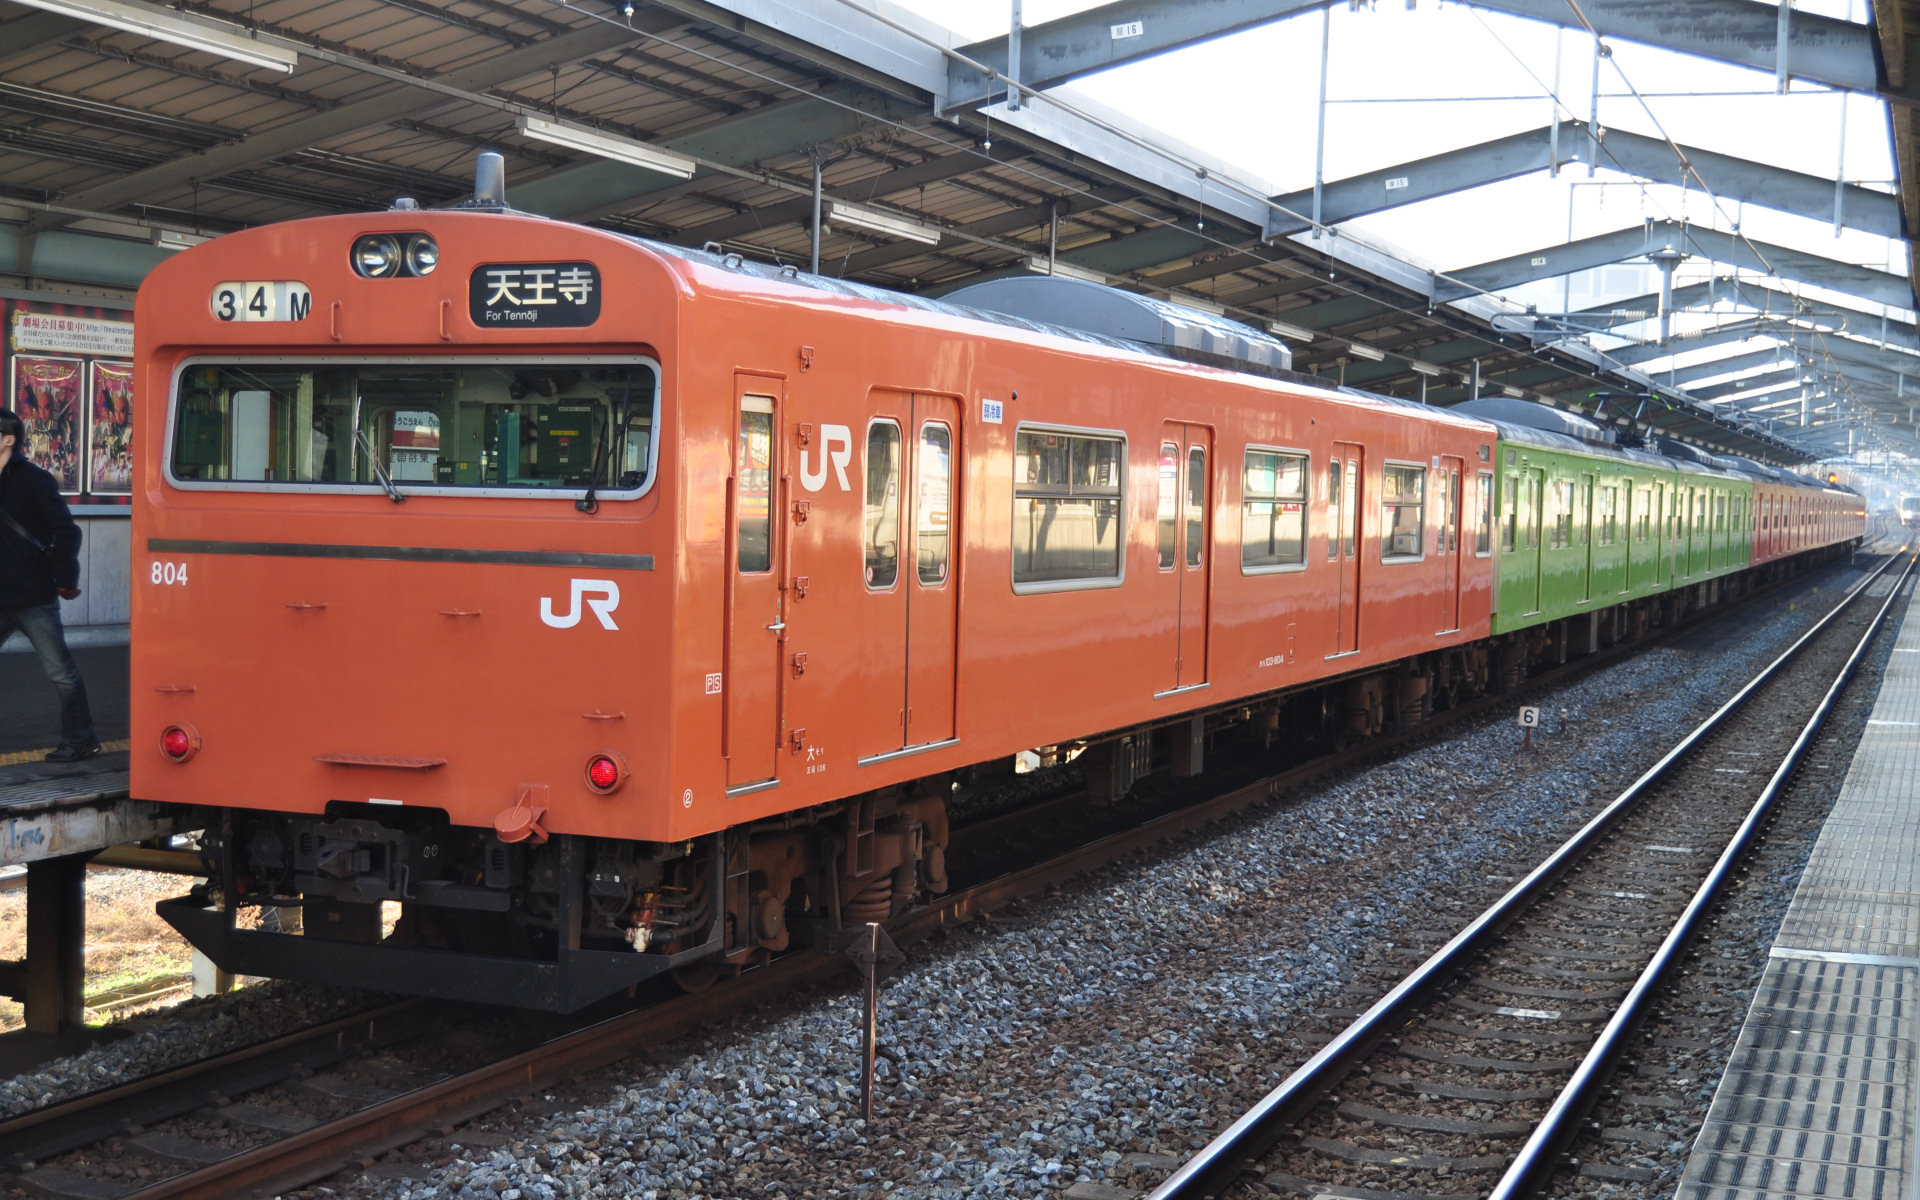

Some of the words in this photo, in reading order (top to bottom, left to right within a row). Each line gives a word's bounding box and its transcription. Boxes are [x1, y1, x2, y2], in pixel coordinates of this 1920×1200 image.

[1128, 24, 1137, 35] 16
[486, 267, 593, 306] 天王寺
[486, 310, 502, 321] For
[503, 309, 538, 323] Tennōji
[799, 423, 852, 493] JR
[151, 561, 188, 586] 804
[540, 578, 620, 631] JR
[1524, 709, 1534, 724] 6
